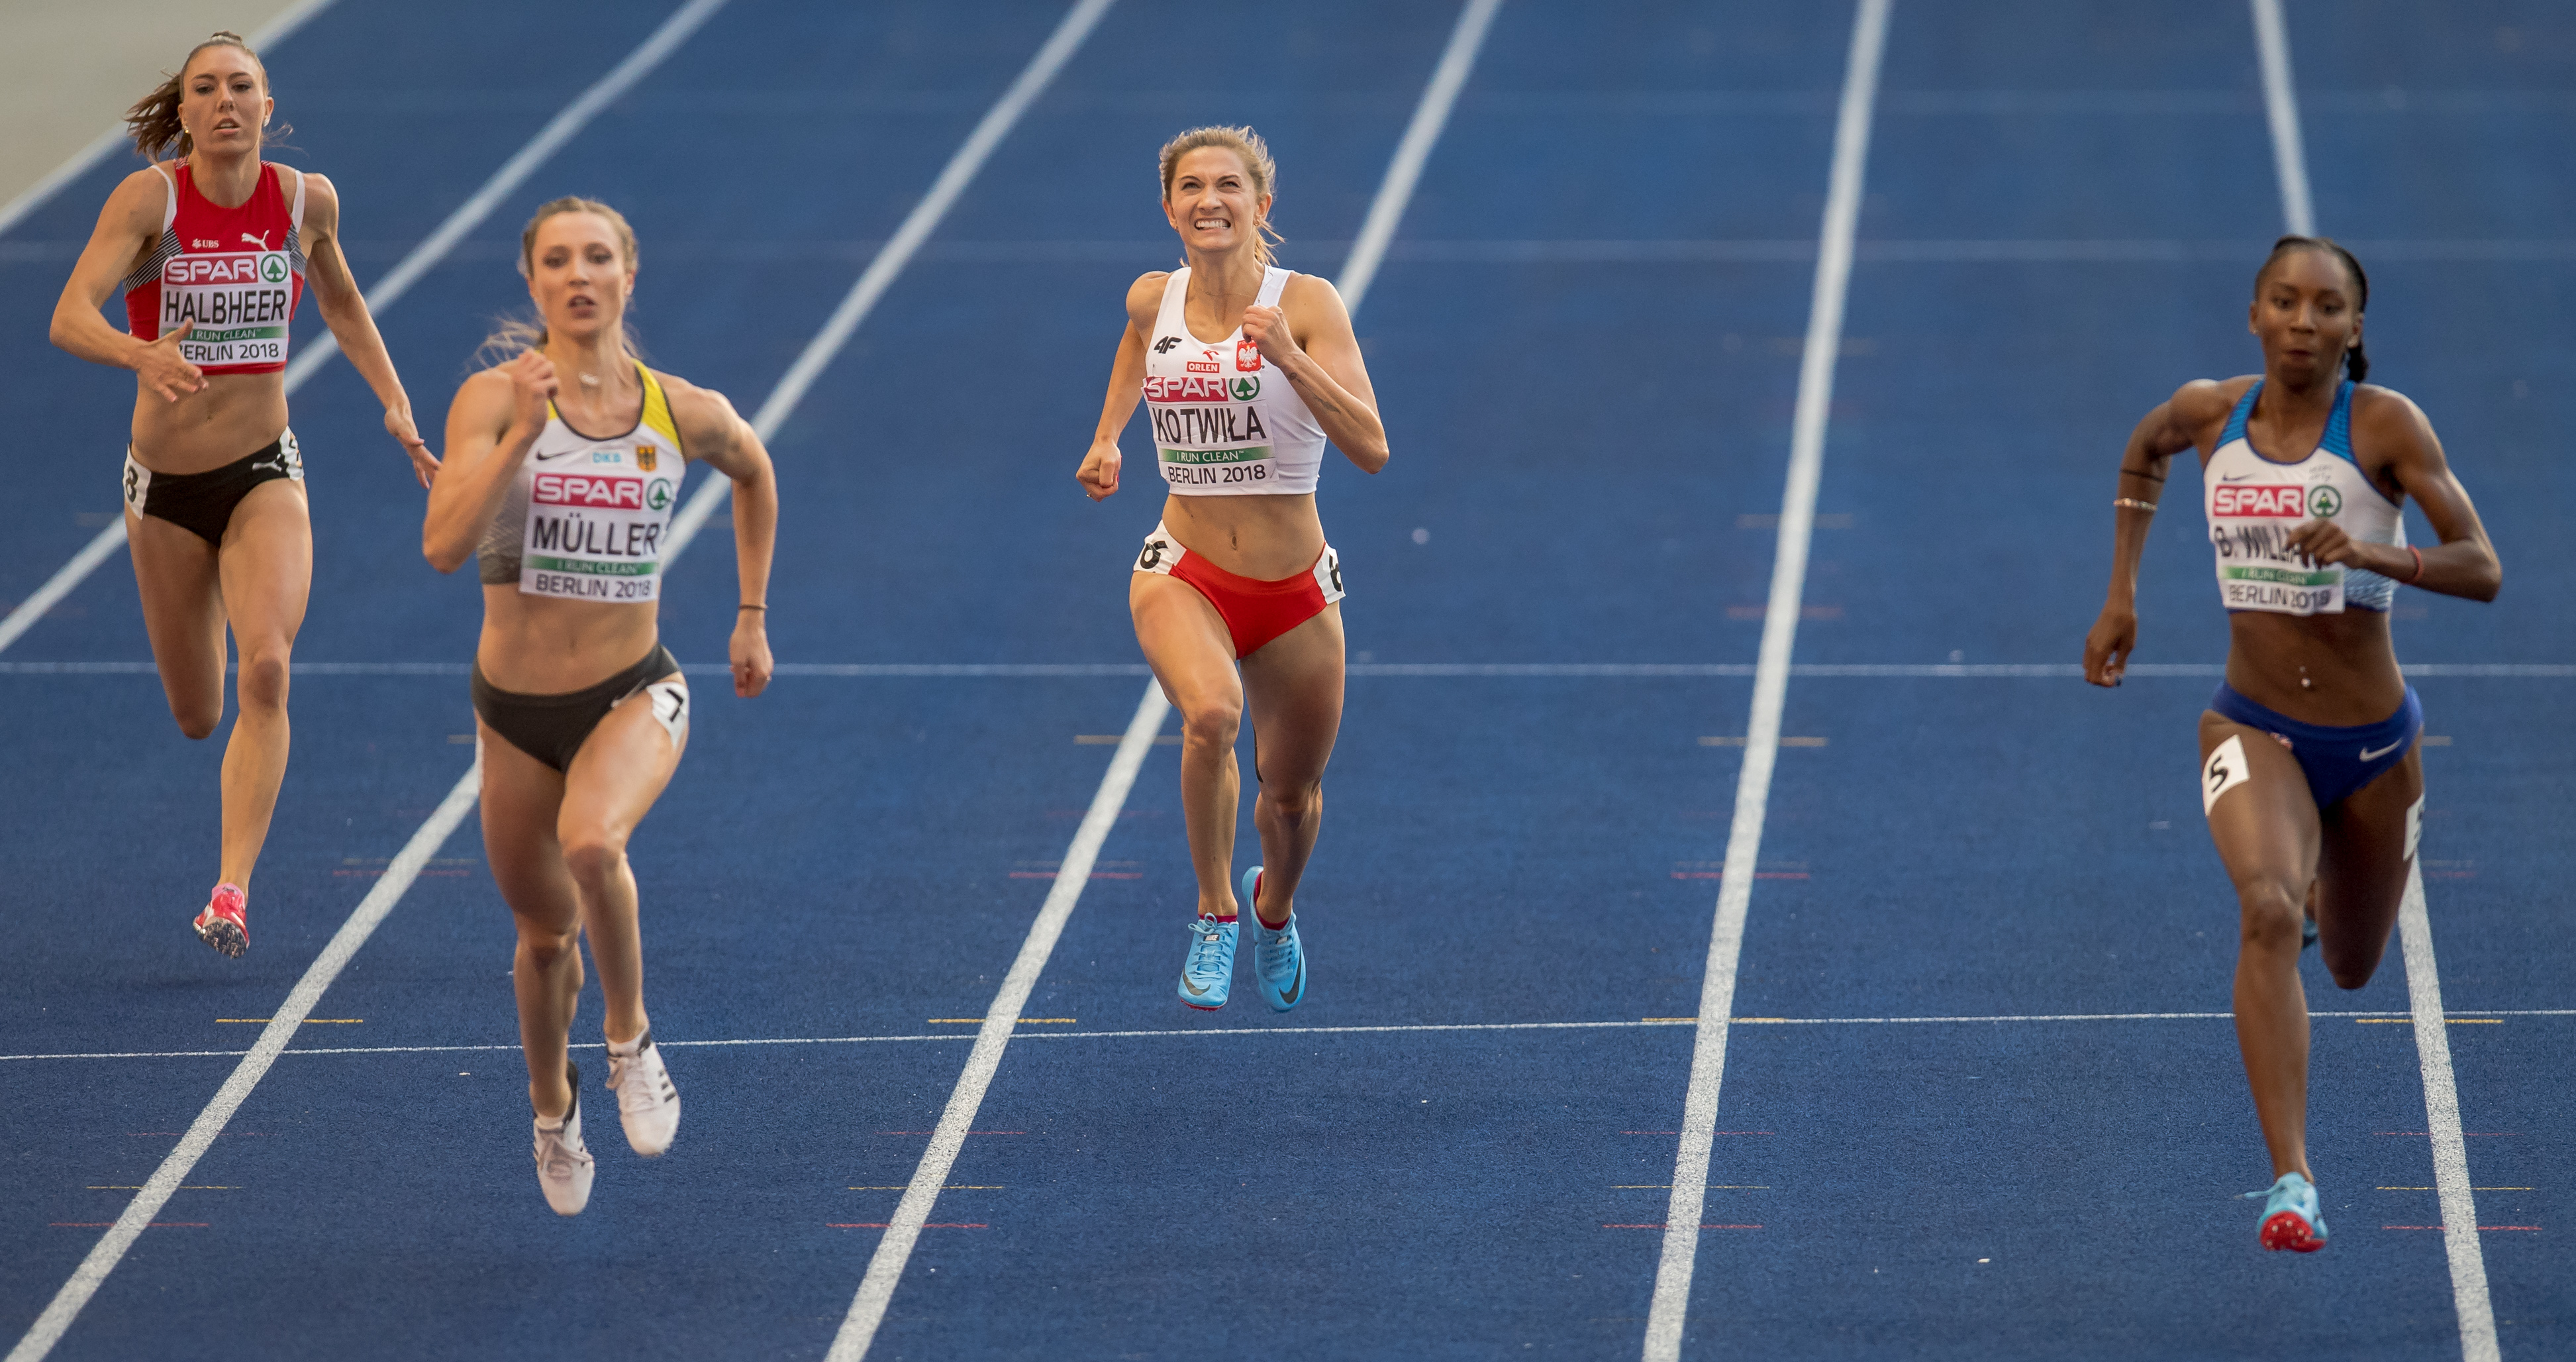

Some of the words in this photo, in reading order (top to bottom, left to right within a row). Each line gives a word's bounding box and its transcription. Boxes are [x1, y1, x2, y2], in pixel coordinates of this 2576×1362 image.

[202, 239, 219, 248] UBS
[167, 258, 256, 282] SPAR
[165, 289, 286, 325] HALBHEER
[196, 331, 221, 341] RUN
[1154, 336, 1182, 354] 4F
[179, 344, 233, 362] ERLIN
[239, 343, 279, 360] 2018
[1188, 362, 1218, 372] ORLEN
[1146, 376, 1225, 398] SPAR
[1152, 405, 1267, 444] KOTWIŁA
[1177, 451, 1179, 461] I
[1181, 452, 1199, 462] RUN
[125, 465, 139, 503] 8
[1168, 466, 1216, 485] BERLIN
[1222, 464, 1266, 483] 2018
[536, 476, 641, 506] SPAR
[2215, 488, 2302, 515] SPAR
[532, 513, 660, 556] MÜLLER
[1140, 540, 1168, 569] 6
[535, 574, 608, 597] BERLIN
[615, 580, 651, 598] 2018
[2229, 584, 2287, 605] BERLIN
[665, 688, 683, 723] 7
[2209, 754, 2229, 793] 5
